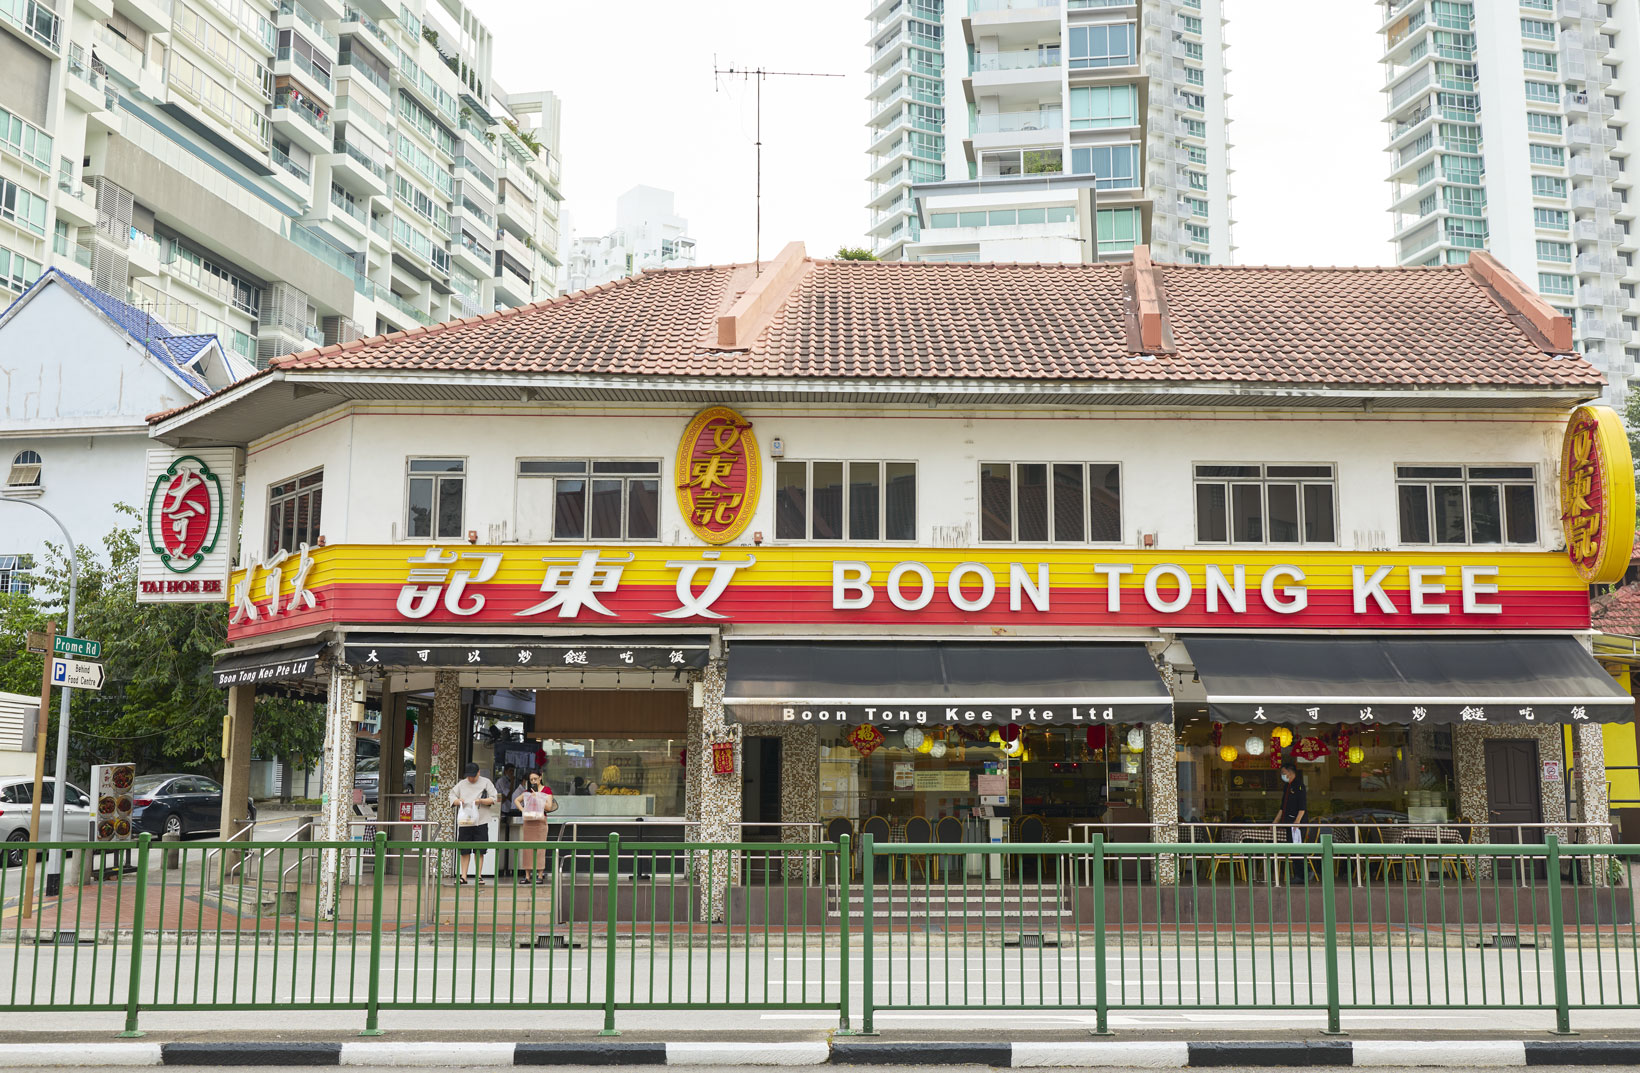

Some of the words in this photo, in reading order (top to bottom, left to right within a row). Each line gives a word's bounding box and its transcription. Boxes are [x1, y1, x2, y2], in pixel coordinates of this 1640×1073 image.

[688, 420, 753, 525] 文東記
[140, 581, 164, 593] TAI
[166, 580, 200, 593] HOE
[202, 580, 221, 592] EE
[832, 560, 1050, 612] BOON
[1094, 563, 1308, 614] TONG
[1352, 564, 1502, 615] KEE
[55, 637, 83, 653] Prome
[86, 642, 97, 655] Rd
[55, 664, 65, 680] P
[75, 664, 90, 674] Behind
[219, 673, 236, 684] Boon
[239, 671, 257, 682] Tong
[258, 667, 274, 679] Kee
[276, 665, 290, 677] Pte
[292, 661, 308, 674] Ltd
[67, 674, 79, 685] Food
[80, 676, 96, 686] Centre
[783, 708, 847, 721] Boon
[865, 708, 927, 724] Tong
[945, 708, 993, 721] Kee
[1011, 708, 1054, 721] Pte
[1072, 707, 1114, 721] Ltd
